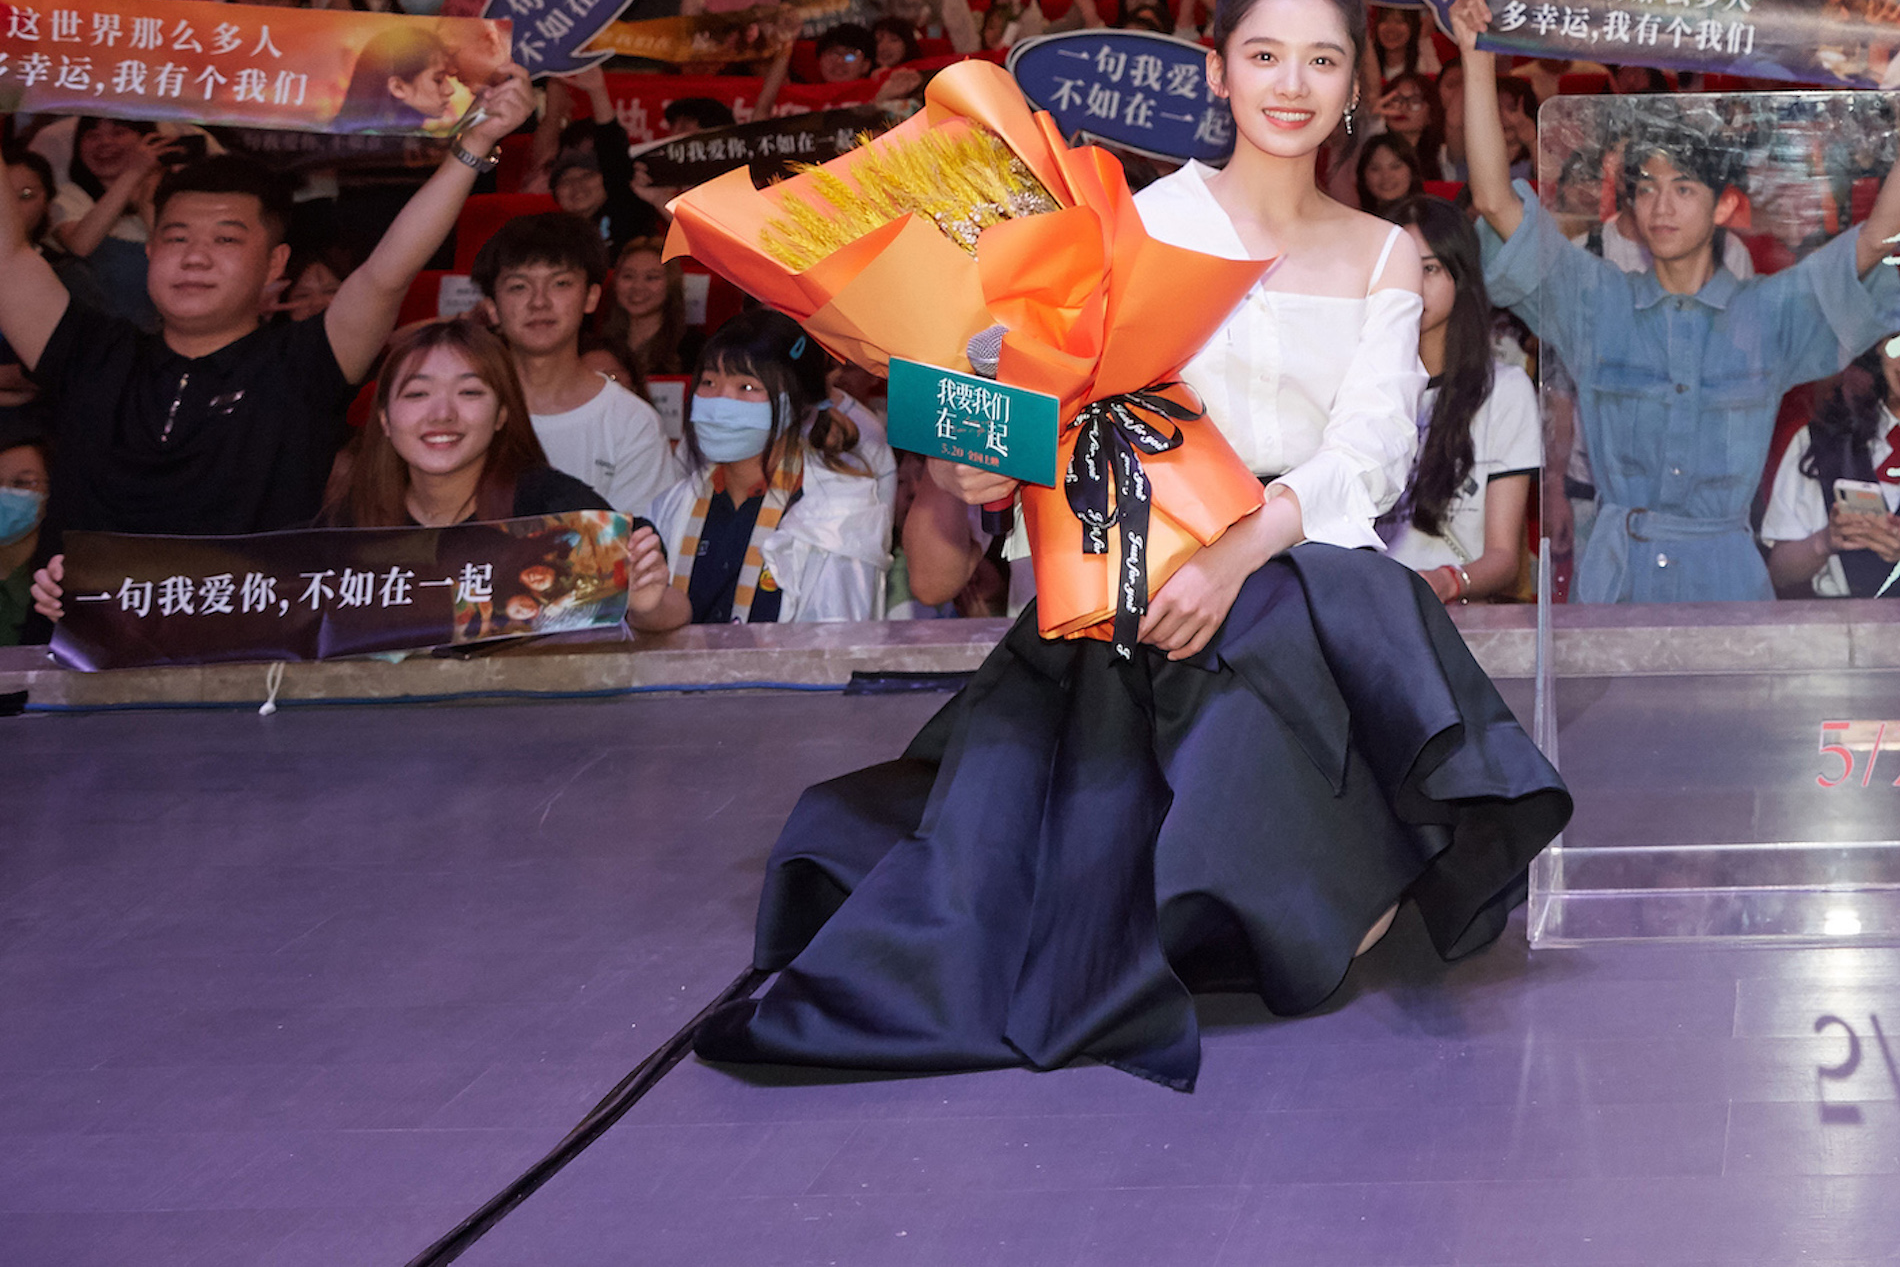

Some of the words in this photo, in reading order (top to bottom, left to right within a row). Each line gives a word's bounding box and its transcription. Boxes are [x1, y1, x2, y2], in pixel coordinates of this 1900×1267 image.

[7, 5, 283, 59] 这世界那么多人
[1056, 44, 1215, 105] 一句我爱
[936, 377, 1010, 424] 我要我们
[935, 407, 1009, 457] 在一起
[76, 562, 495, 619] 一句我爱你,不如在一起
